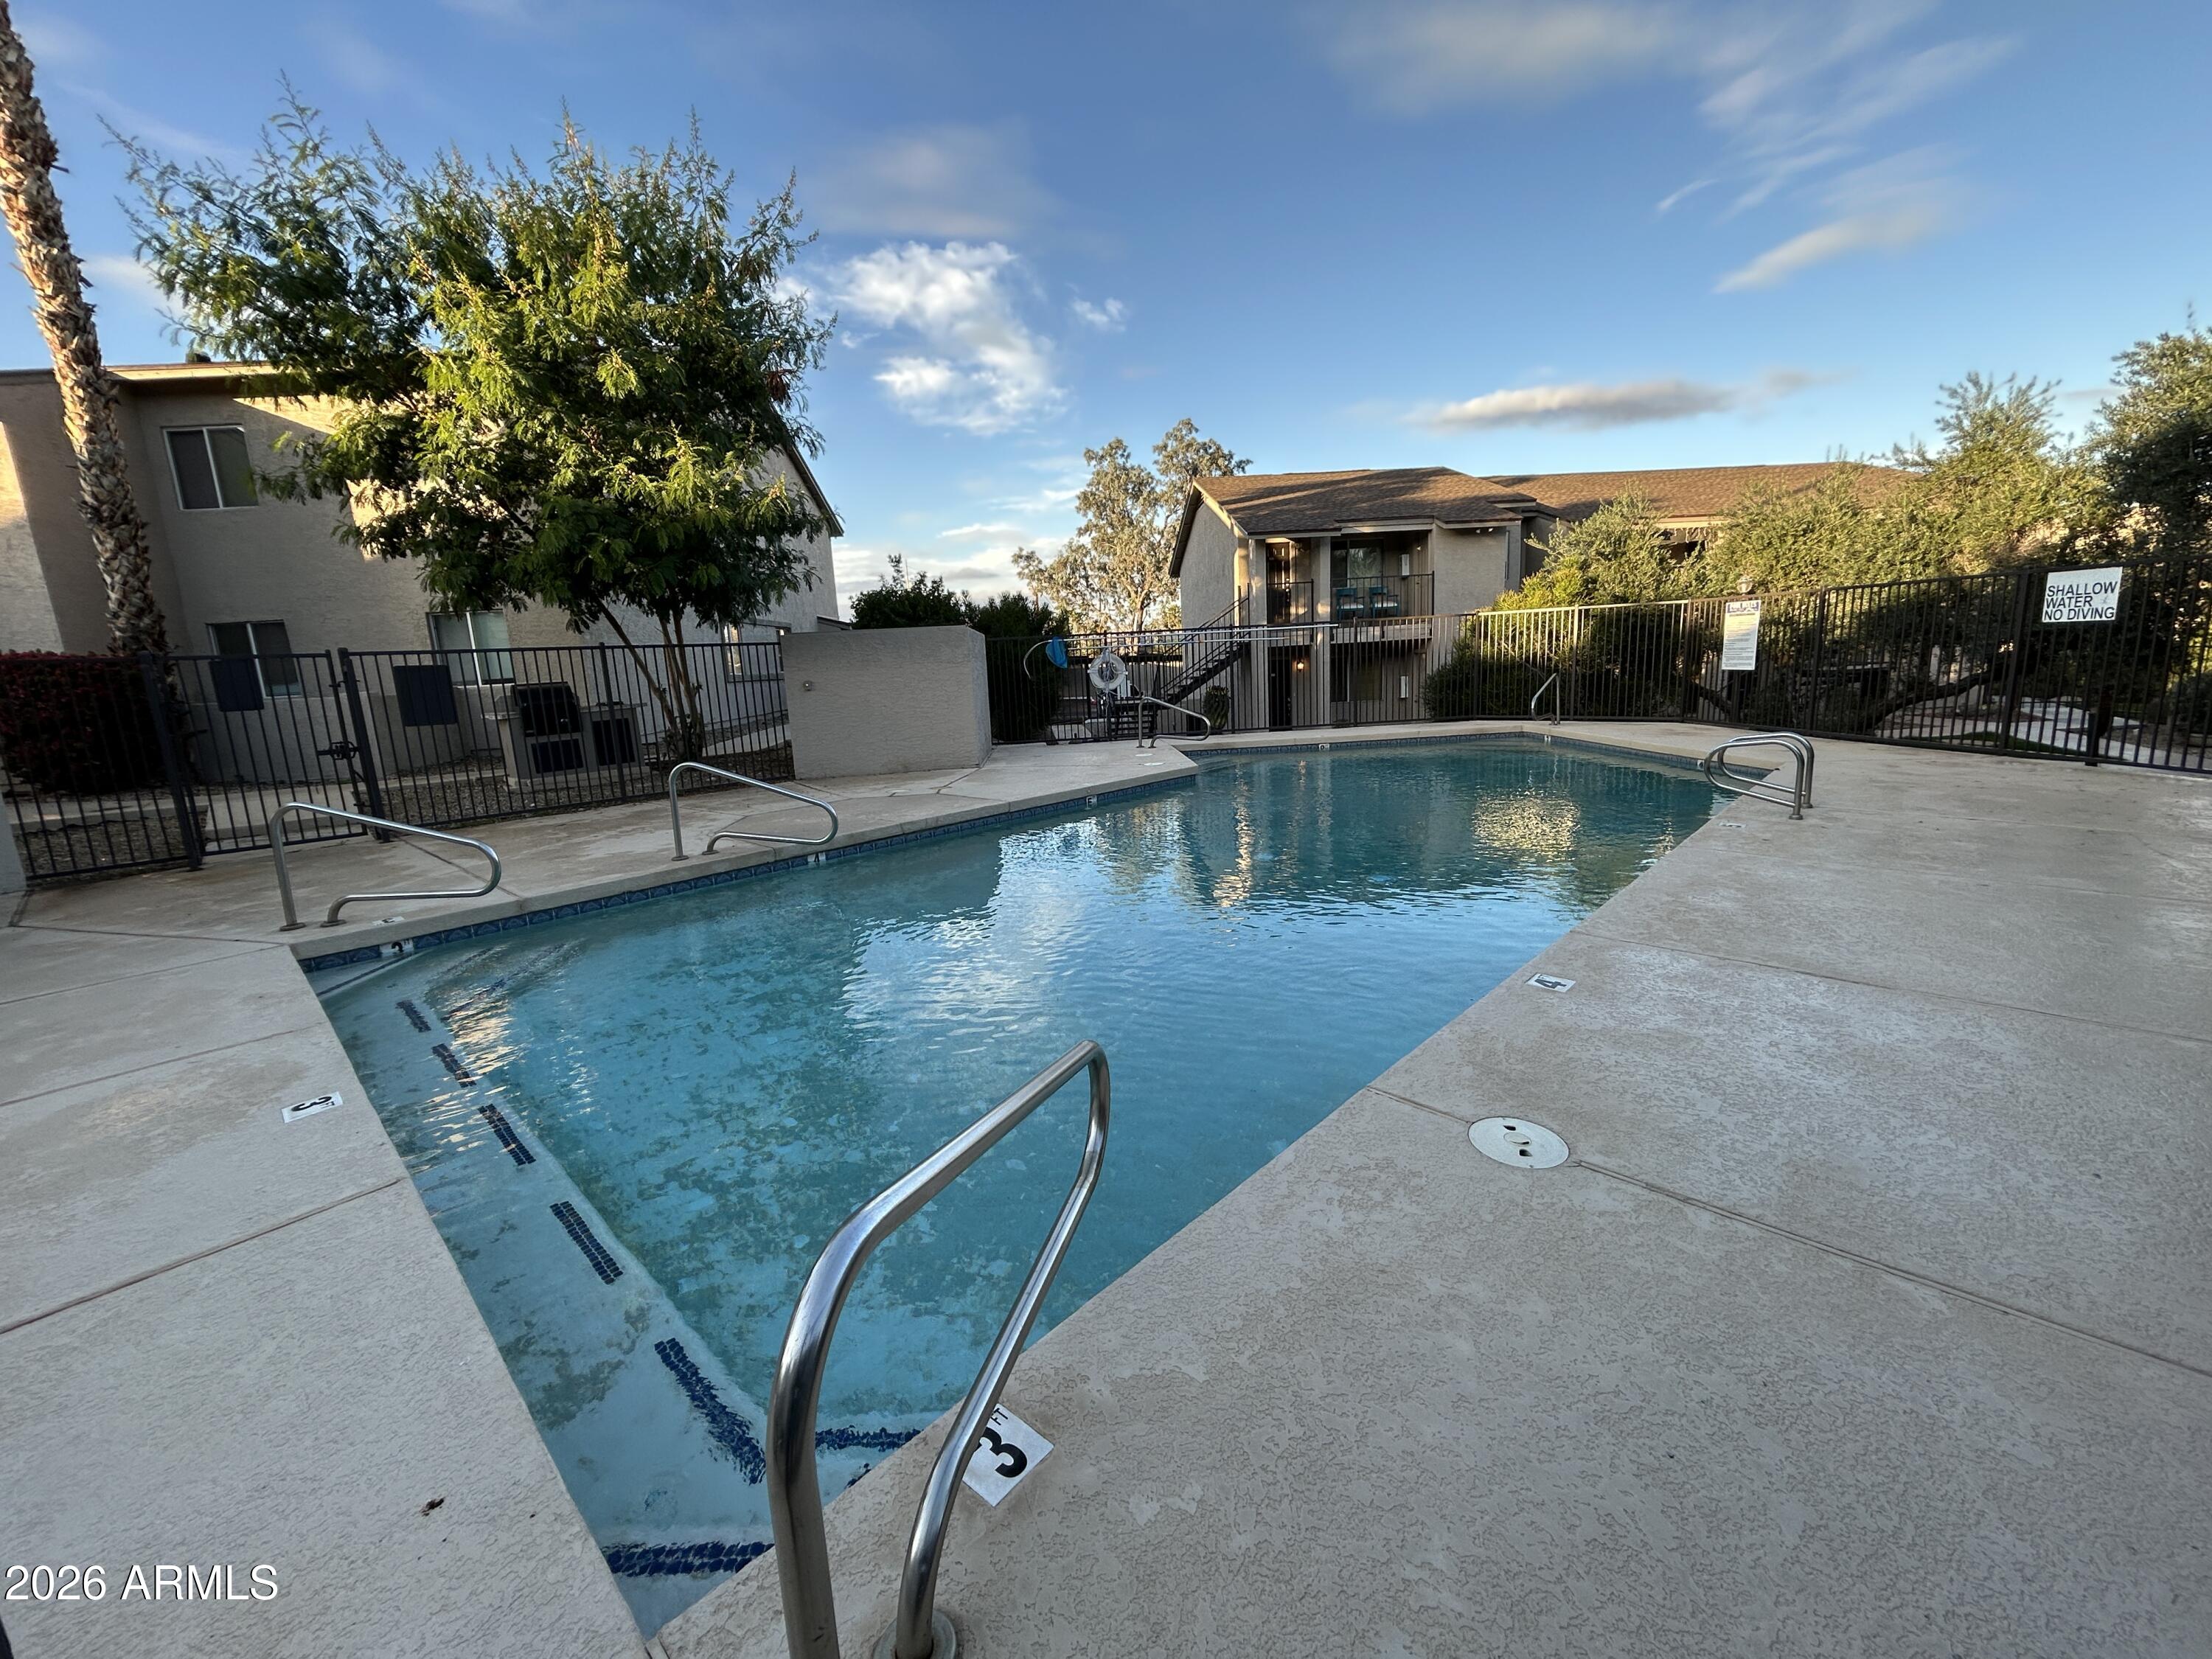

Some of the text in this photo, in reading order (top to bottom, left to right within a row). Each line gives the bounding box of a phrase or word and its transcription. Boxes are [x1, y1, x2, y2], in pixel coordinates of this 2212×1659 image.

[2047, 581, 2118, 597] SHALLOW
[2046, 596, 2093, 609] WATER
[2044, 607, 2115, 621] NO DIVING
[1534, 978, 1567, 989] 4
[291, 1096, 333, 1112] 3
[973, 1427, 1028, 1478] 3
